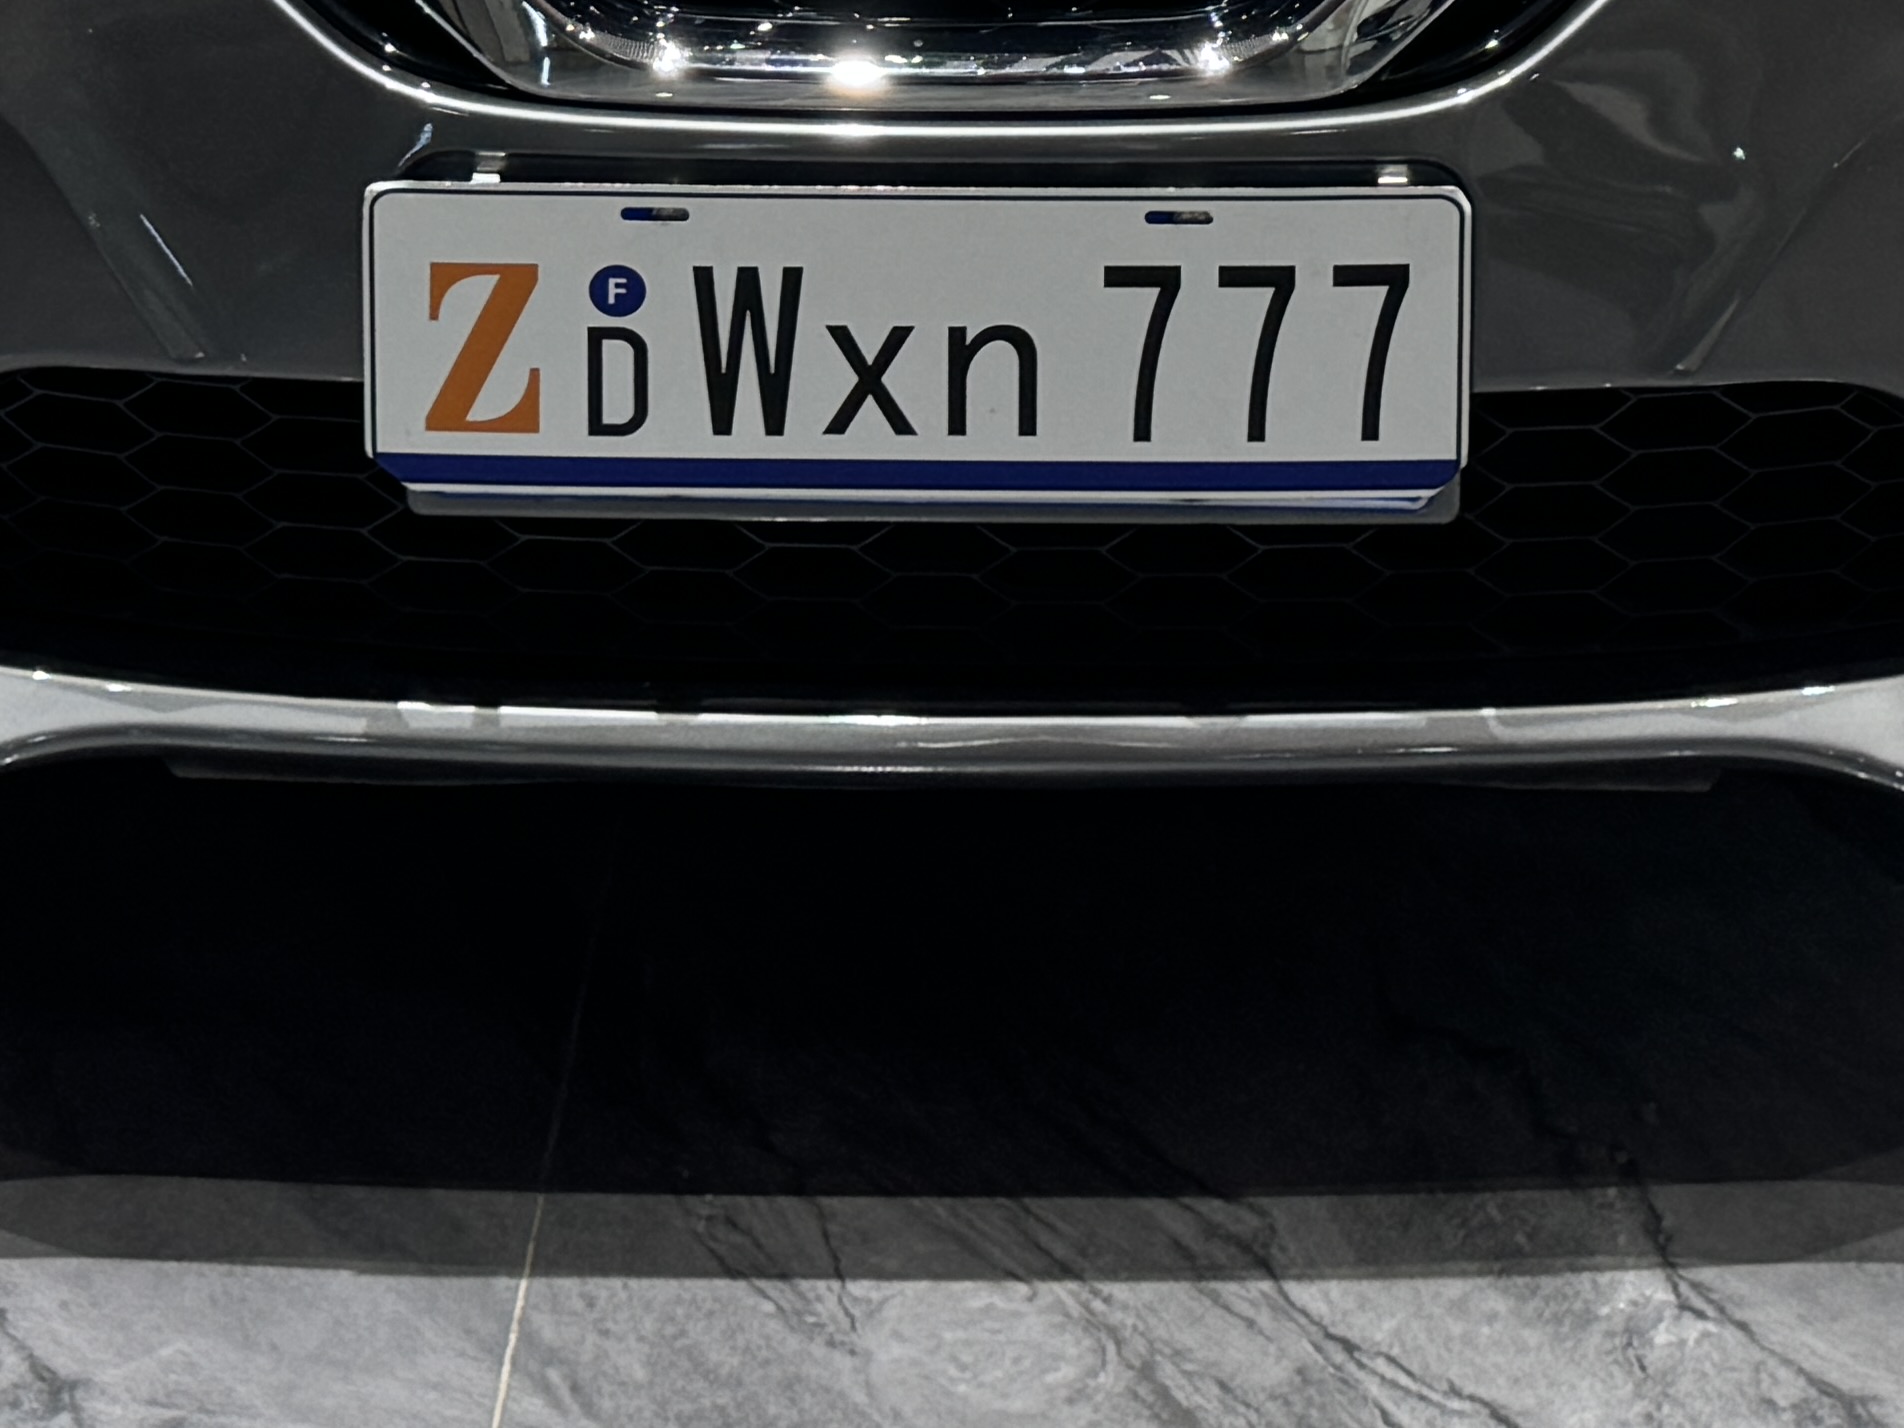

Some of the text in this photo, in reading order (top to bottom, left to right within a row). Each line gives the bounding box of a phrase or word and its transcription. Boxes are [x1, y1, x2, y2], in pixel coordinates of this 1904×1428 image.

[425, 262, 541, 434] Z
[608, 277, 628, 305] F
[1103, 264, 1410, 443] 777
